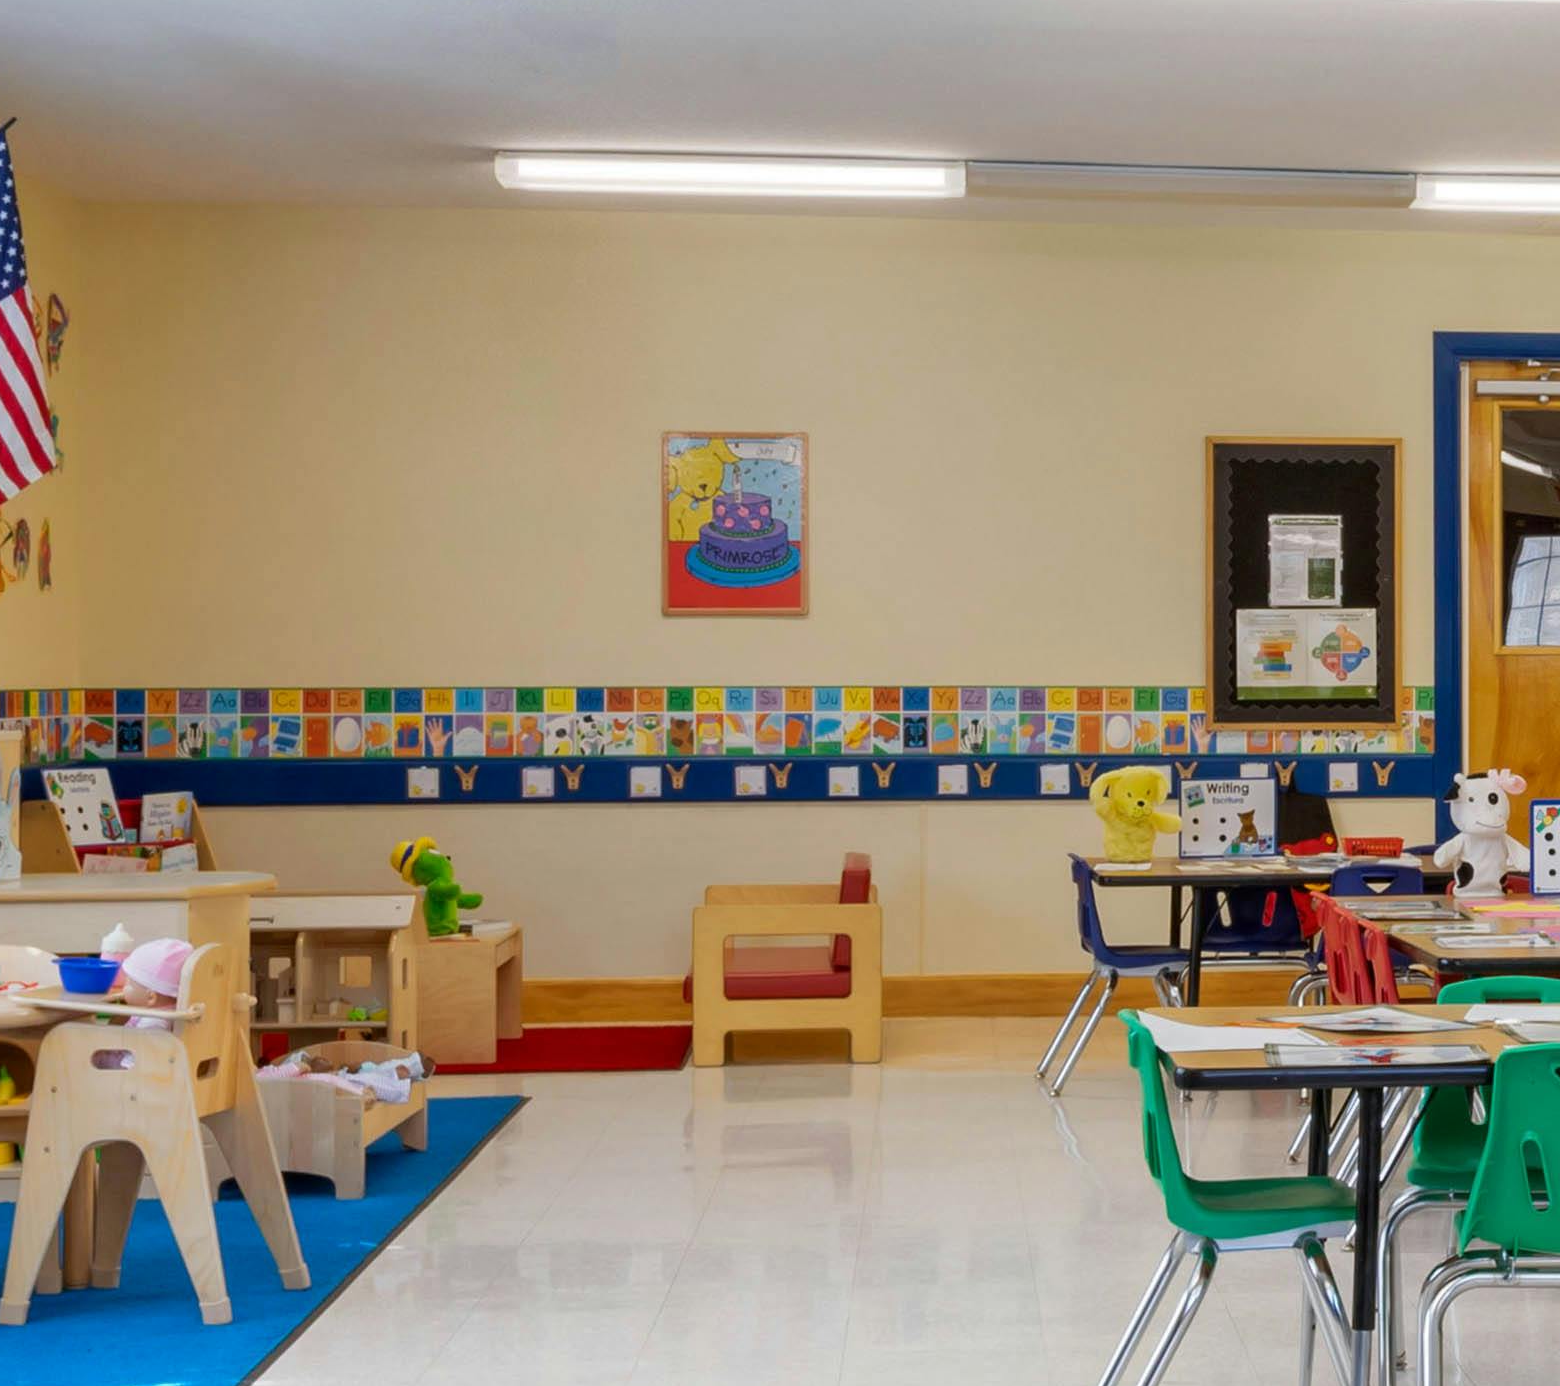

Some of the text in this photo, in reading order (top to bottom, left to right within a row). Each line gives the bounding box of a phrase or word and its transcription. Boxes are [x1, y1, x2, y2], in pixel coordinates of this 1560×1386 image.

[213, 694, 237, 708] Aa
[697, 690, 720, 711] Qq
[818, 690, 839, 706] Uu
[936, 691, 955, 709] Yy
[964, 691, 983, 706] Zz
[993, 690, 1016, 705] Aa
[1051, 690, 1071, 705] Cc
[1079, 690, 1100, 705] Dd
[1109, 690, 1129, 705] Ee
[57, 772, 96, 784] Reading
[1207, 783, 1249, 796] Writing
